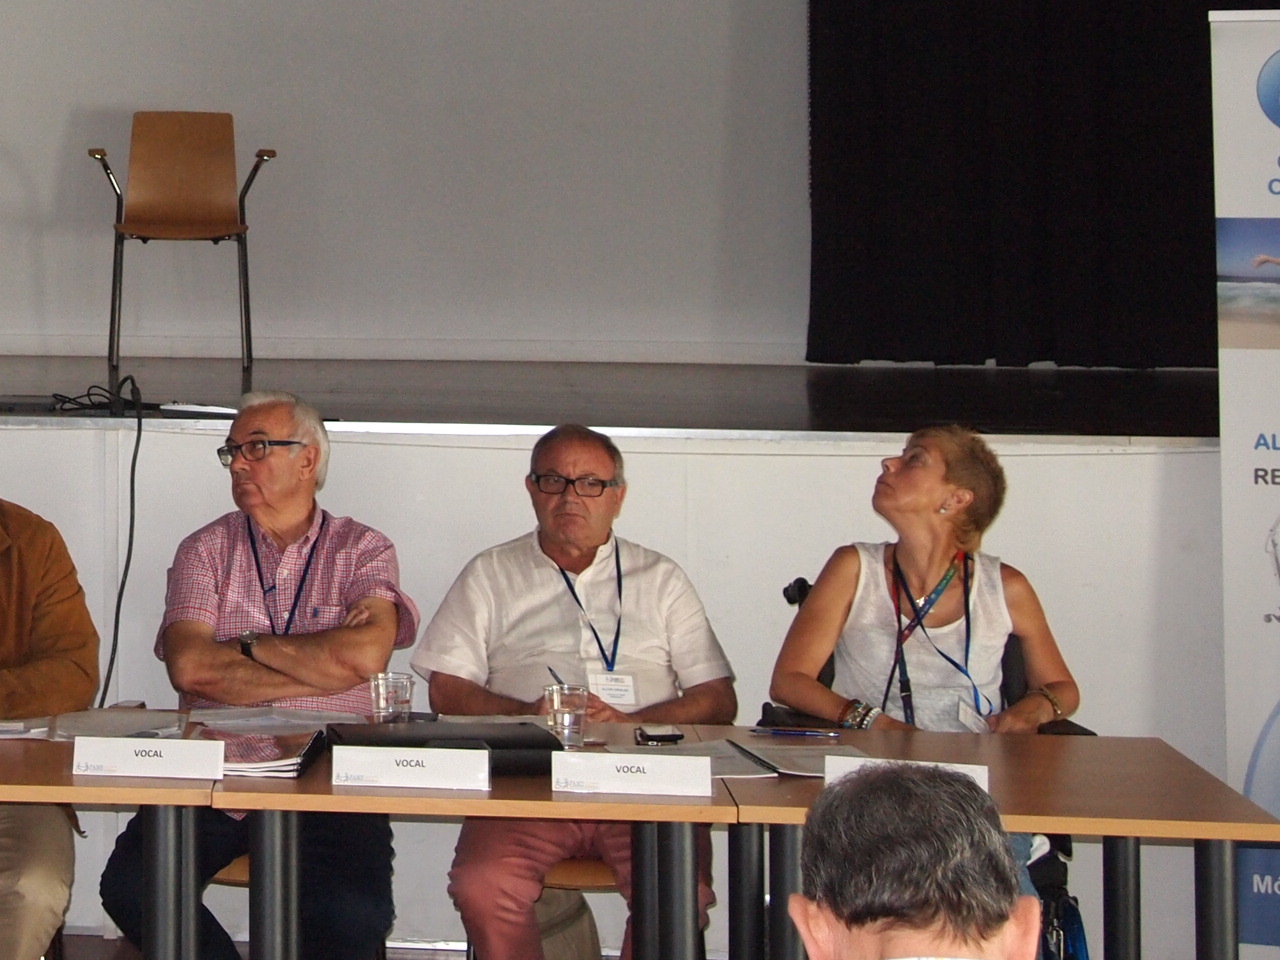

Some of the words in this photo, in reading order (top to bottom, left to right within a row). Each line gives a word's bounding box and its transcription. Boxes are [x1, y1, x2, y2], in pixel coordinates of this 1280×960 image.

[134, 749, 164, 758] VOCAL
[394, 759, 426, 768] VOCAL
[615, 765, 647, 775] VOCAL
